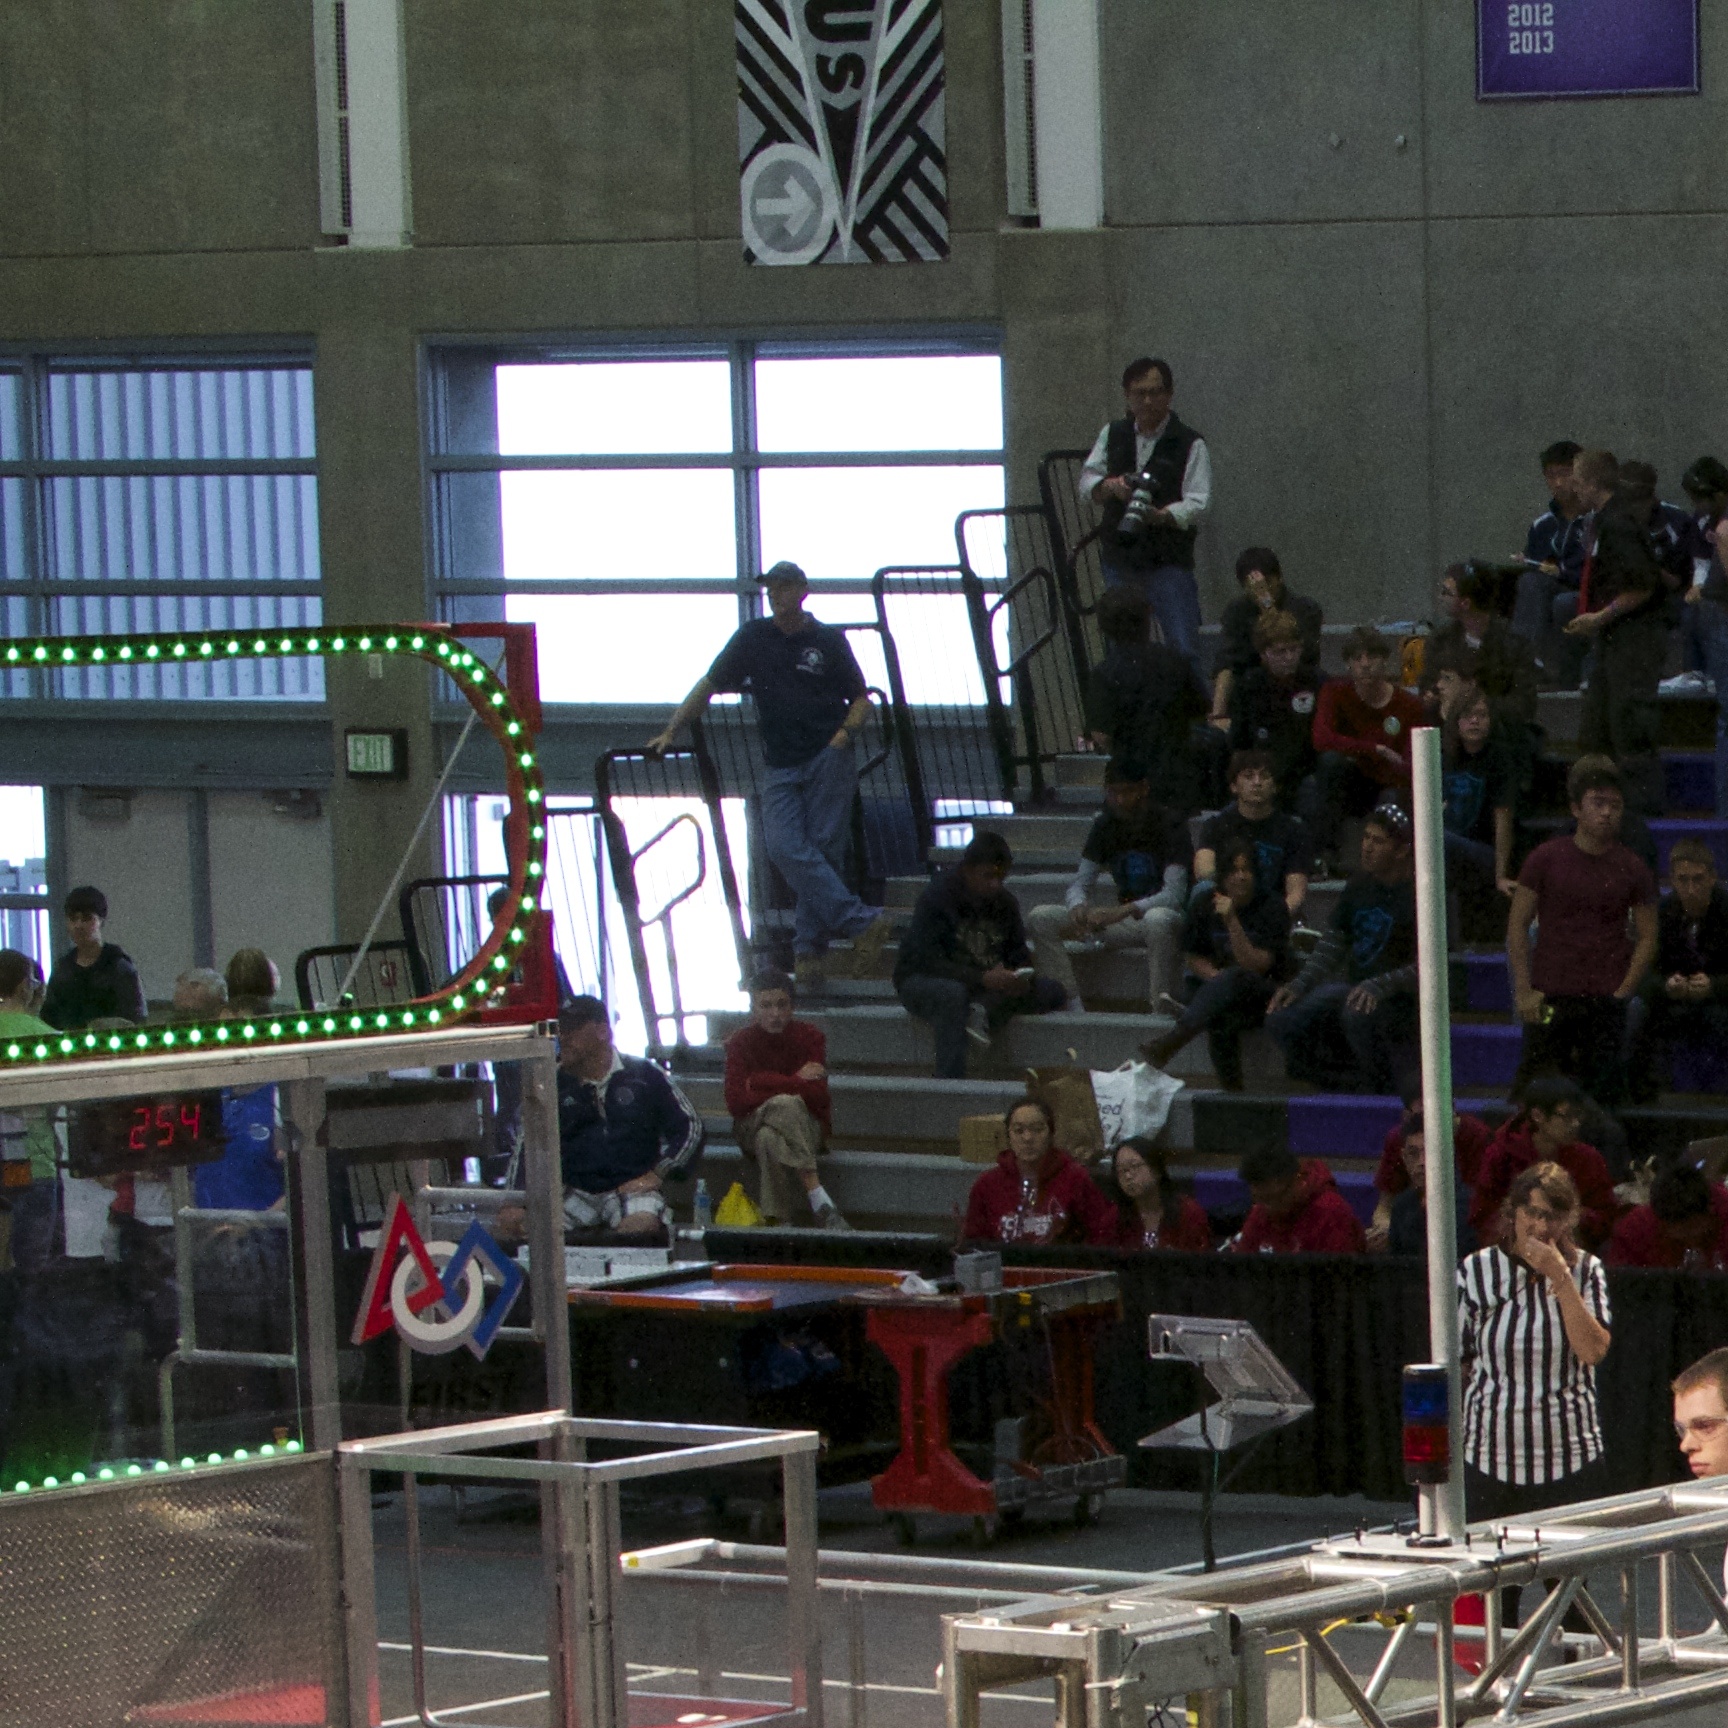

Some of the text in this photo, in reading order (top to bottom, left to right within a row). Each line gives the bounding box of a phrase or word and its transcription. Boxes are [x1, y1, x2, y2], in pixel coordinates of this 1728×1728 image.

[1508, 4, 1555, 27] 2012
[1509, 31, 1555, 54] 2013
[128, 1102, 204, 1151] 254
